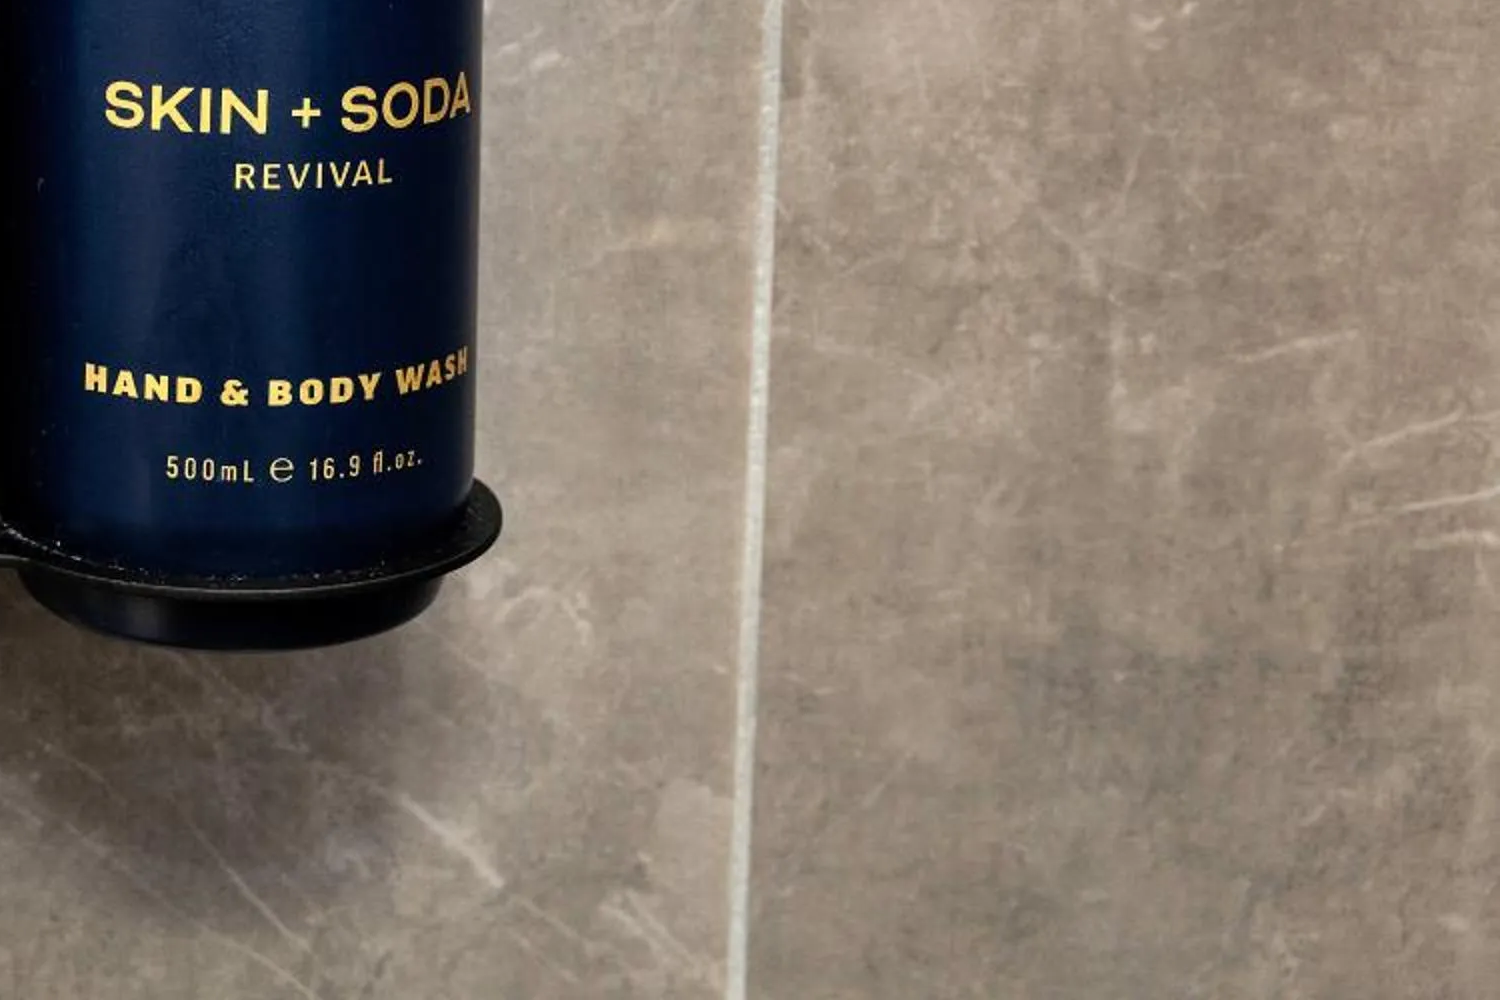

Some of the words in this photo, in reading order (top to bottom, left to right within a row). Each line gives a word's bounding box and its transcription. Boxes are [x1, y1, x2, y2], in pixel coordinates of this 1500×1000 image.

[104, 80, 269, 135] SKIN
[291, 97, 322, 129] +
[341, 71, 472, 133] SODA
[234, 158, 393, 190] REVIVAL
[84, 362, 203, 405] HAND
[220, 379, 249, 407] &
[268, 371, 382, 407] BODY
[395, 346, 469, 395] WASH
[166, 455, 254, 483] 500mL
[309, 454, 362, 481] 16.9
